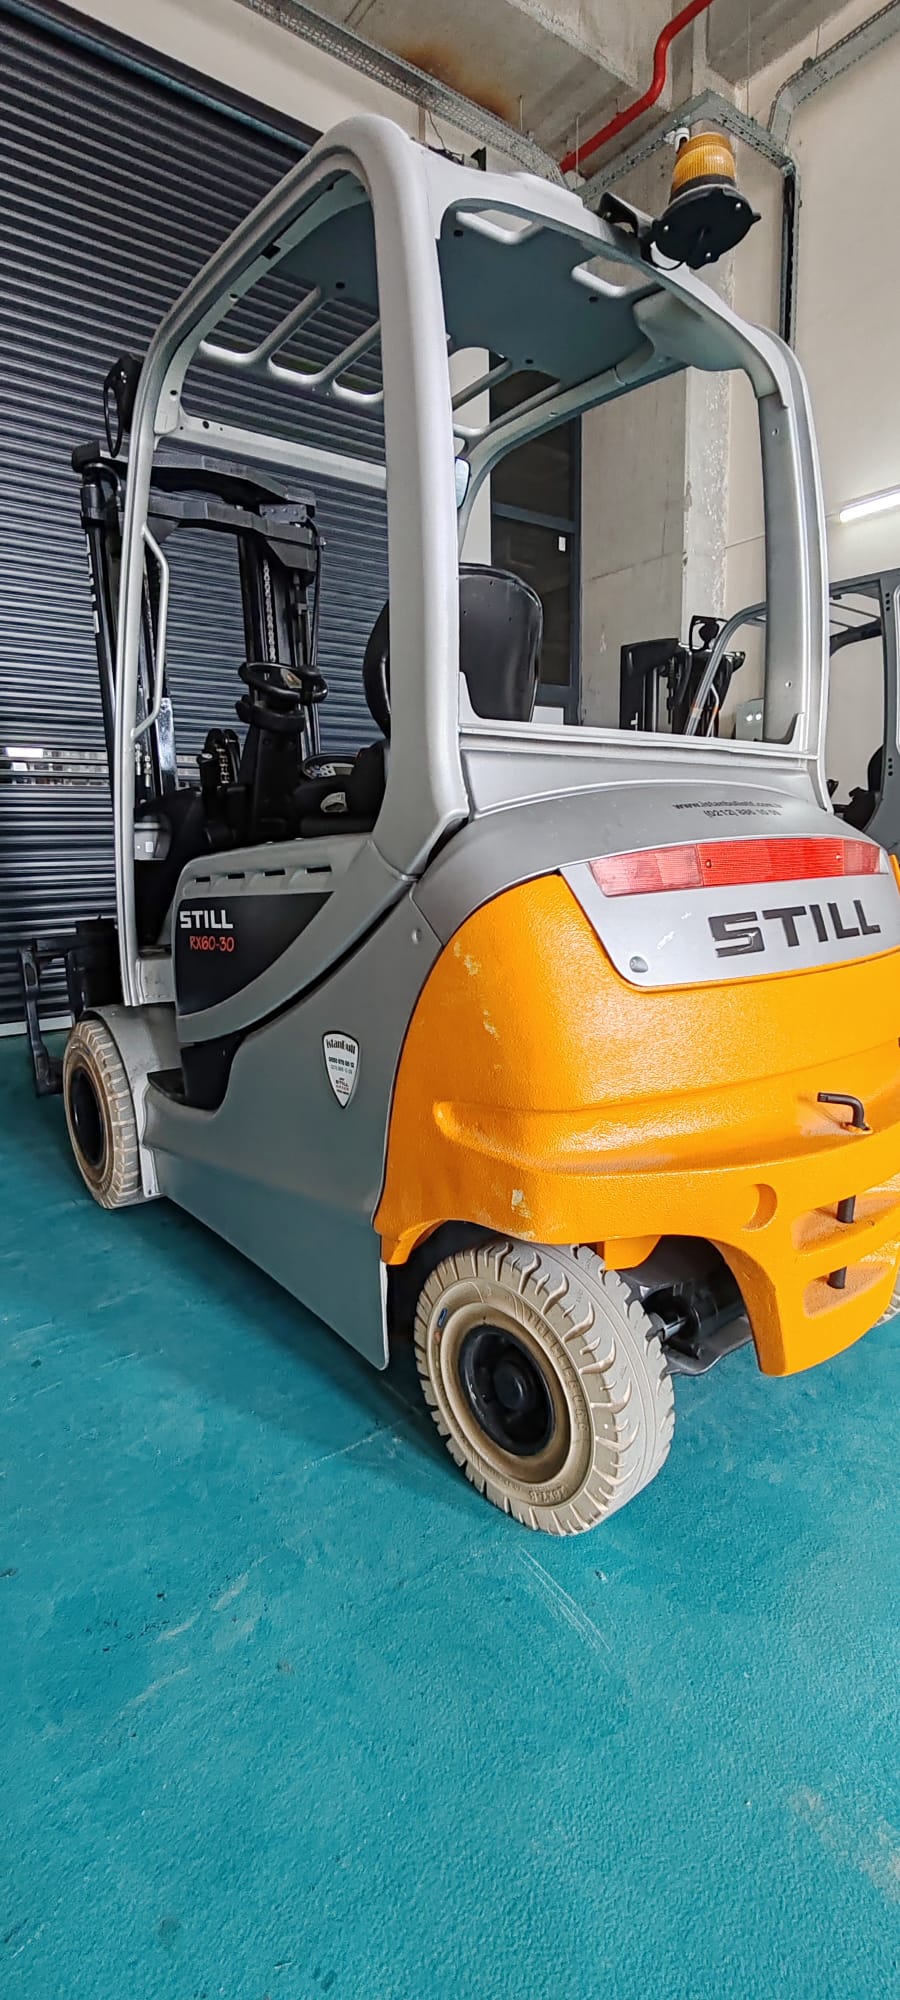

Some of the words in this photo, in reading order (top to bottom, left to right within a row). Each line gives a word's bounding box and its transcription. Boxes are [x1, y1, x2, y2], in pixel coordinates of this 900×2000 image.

[703, 809, 739, 818] (0212)
[179, 909, 234, 929] STILL
[707, 899, 882, 958] STILL
[189, 935, 235, 953] RX60-30
